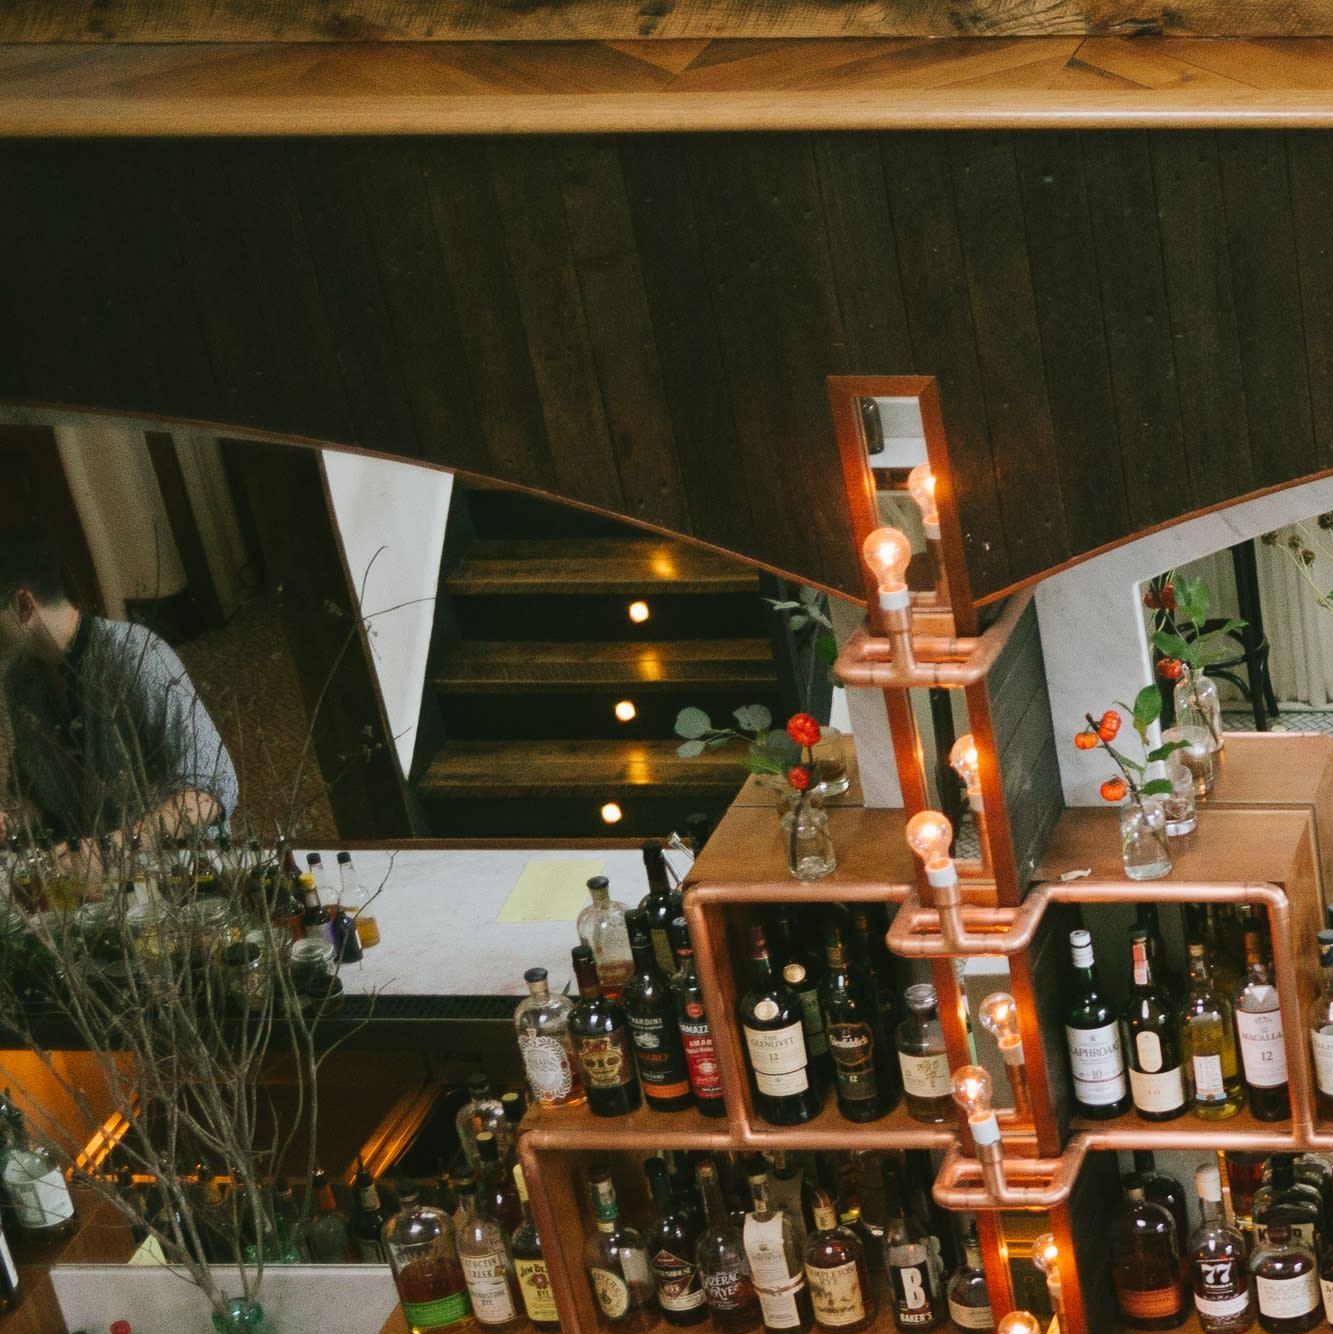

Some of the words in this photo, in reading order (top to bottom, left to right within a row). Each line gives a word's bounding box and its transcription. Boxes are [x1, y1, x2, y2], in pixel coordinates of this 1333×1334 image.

[1242, 1031, 1283, 1041] MACALLA
[1261, 1051, 1273, 1062] 12
[1201, 1263, 1231, 1284] 77
[900, 1268, 926, 1309] B
[900, 1312, 933, 1322] BAKER'S
